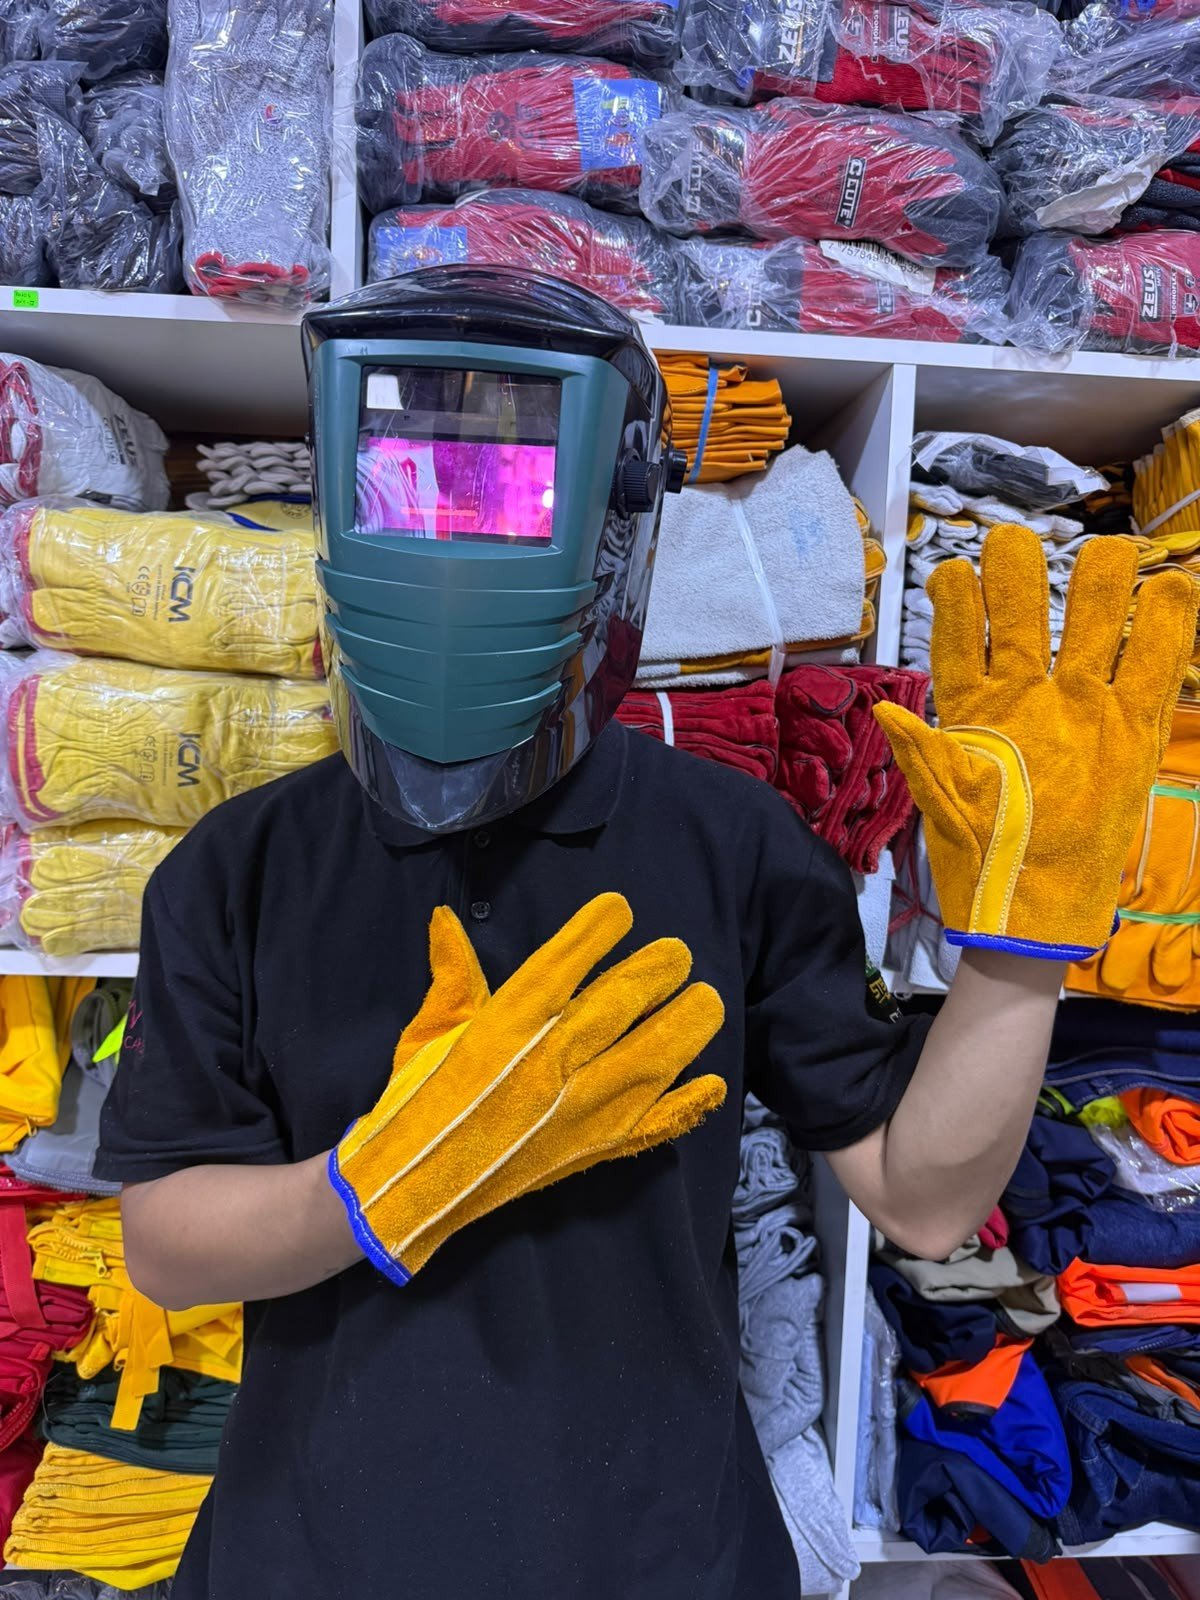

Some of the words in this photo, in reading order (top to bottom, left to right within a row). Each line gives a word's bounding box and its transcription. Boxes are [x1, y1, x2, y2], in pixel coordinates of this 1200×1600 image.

[840, 158, 863, 219] CLUTE
[884, 255, 920, 275] 00632
[1141, 268, 1156, 318] ZEUS
